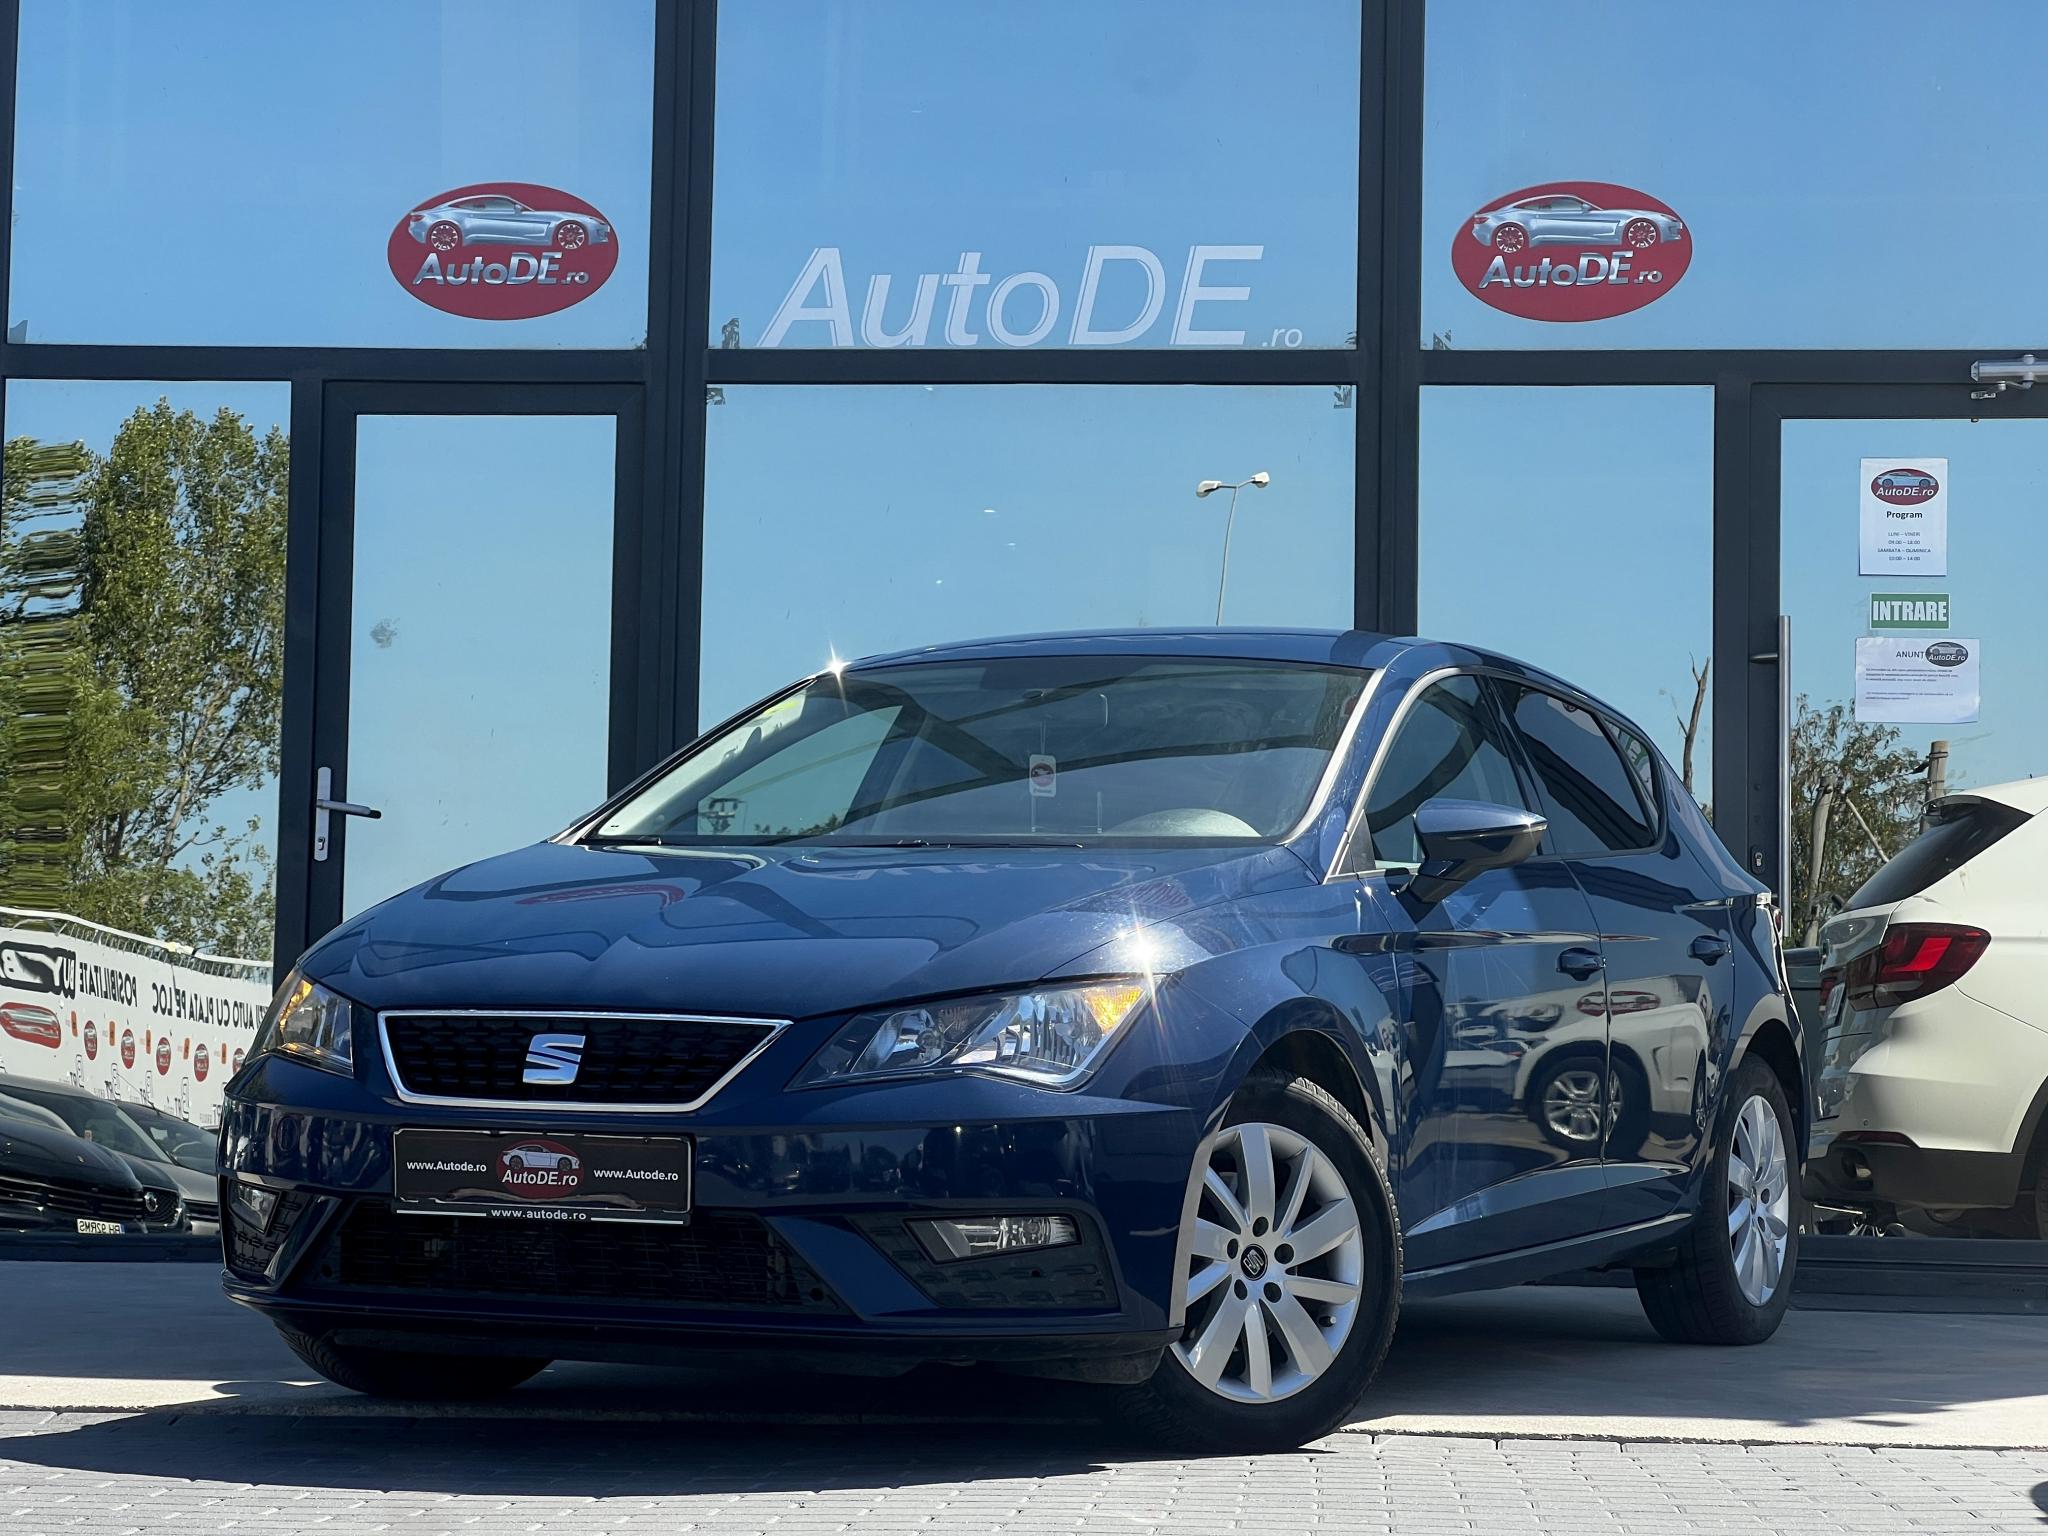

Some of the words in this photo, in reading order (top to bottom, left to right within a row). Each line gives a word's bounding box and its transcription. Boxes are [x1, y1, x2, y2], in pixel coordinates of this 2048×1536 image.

[412, 252, 590, 286] AutoDE.ro
[1478, 250, 1663, 289] AutoDE.ro
[1875, 487, 1935, 497] AutoDE.ro
[1886, 511, 1923, 520] Program
[1872, 600, 1948, 622] INTRARE
[1928, 654, 1966, 662] AutoDE.ro
[406, 1160, 488, 1173] www.Autode.ro
[501, 1169, 578, 1187] AutoDE.ro
[593, 1168, 679, 1182] www.Autode.ro
[491, 1207, 587, 1221] www.autode.ro
